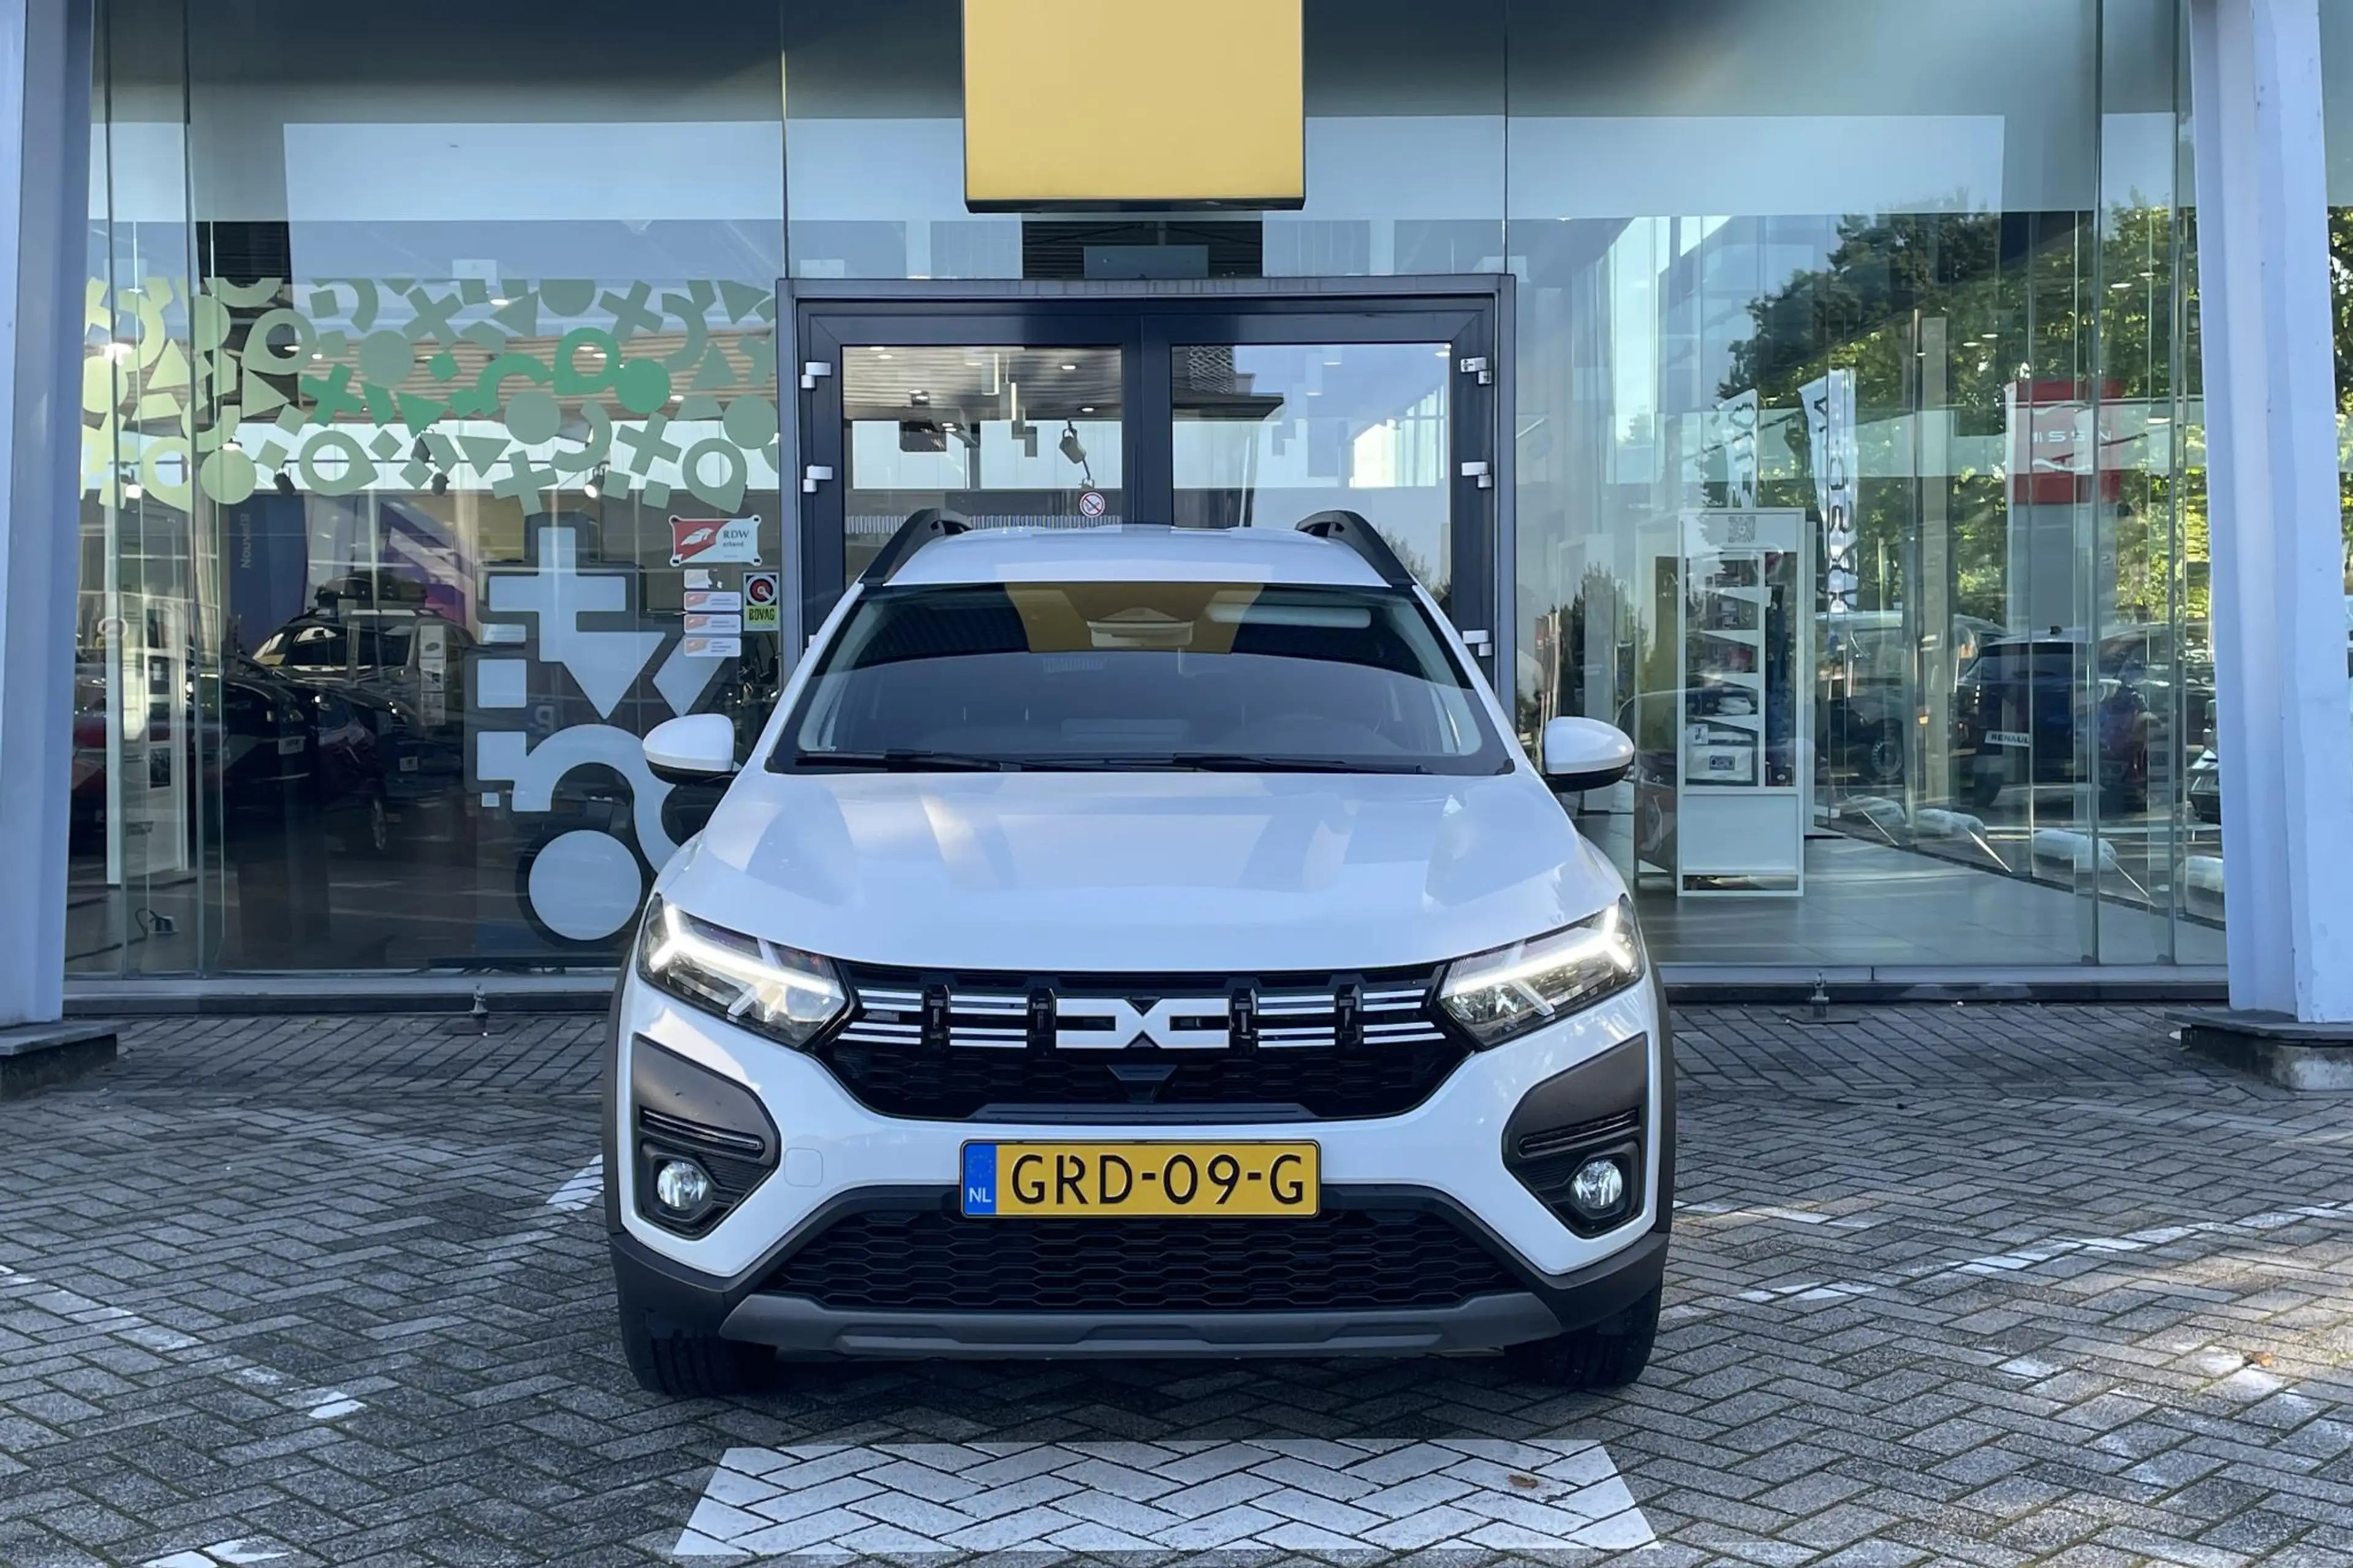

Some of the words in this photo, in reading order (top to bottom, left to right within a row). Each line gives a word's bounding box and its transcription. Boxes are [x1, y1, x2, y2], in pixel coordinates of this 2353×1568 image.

[2033, 430, 2112, 444] ISSN
[723, 529, 749, 539] RDW
[749, 608, 775, 621] BOVAG
[1991, 733, 2029, 743] RENAUL
[1012, 1154, 1303, 1205] GRD-09-G
[969, 1187, 991, 1203] NL
